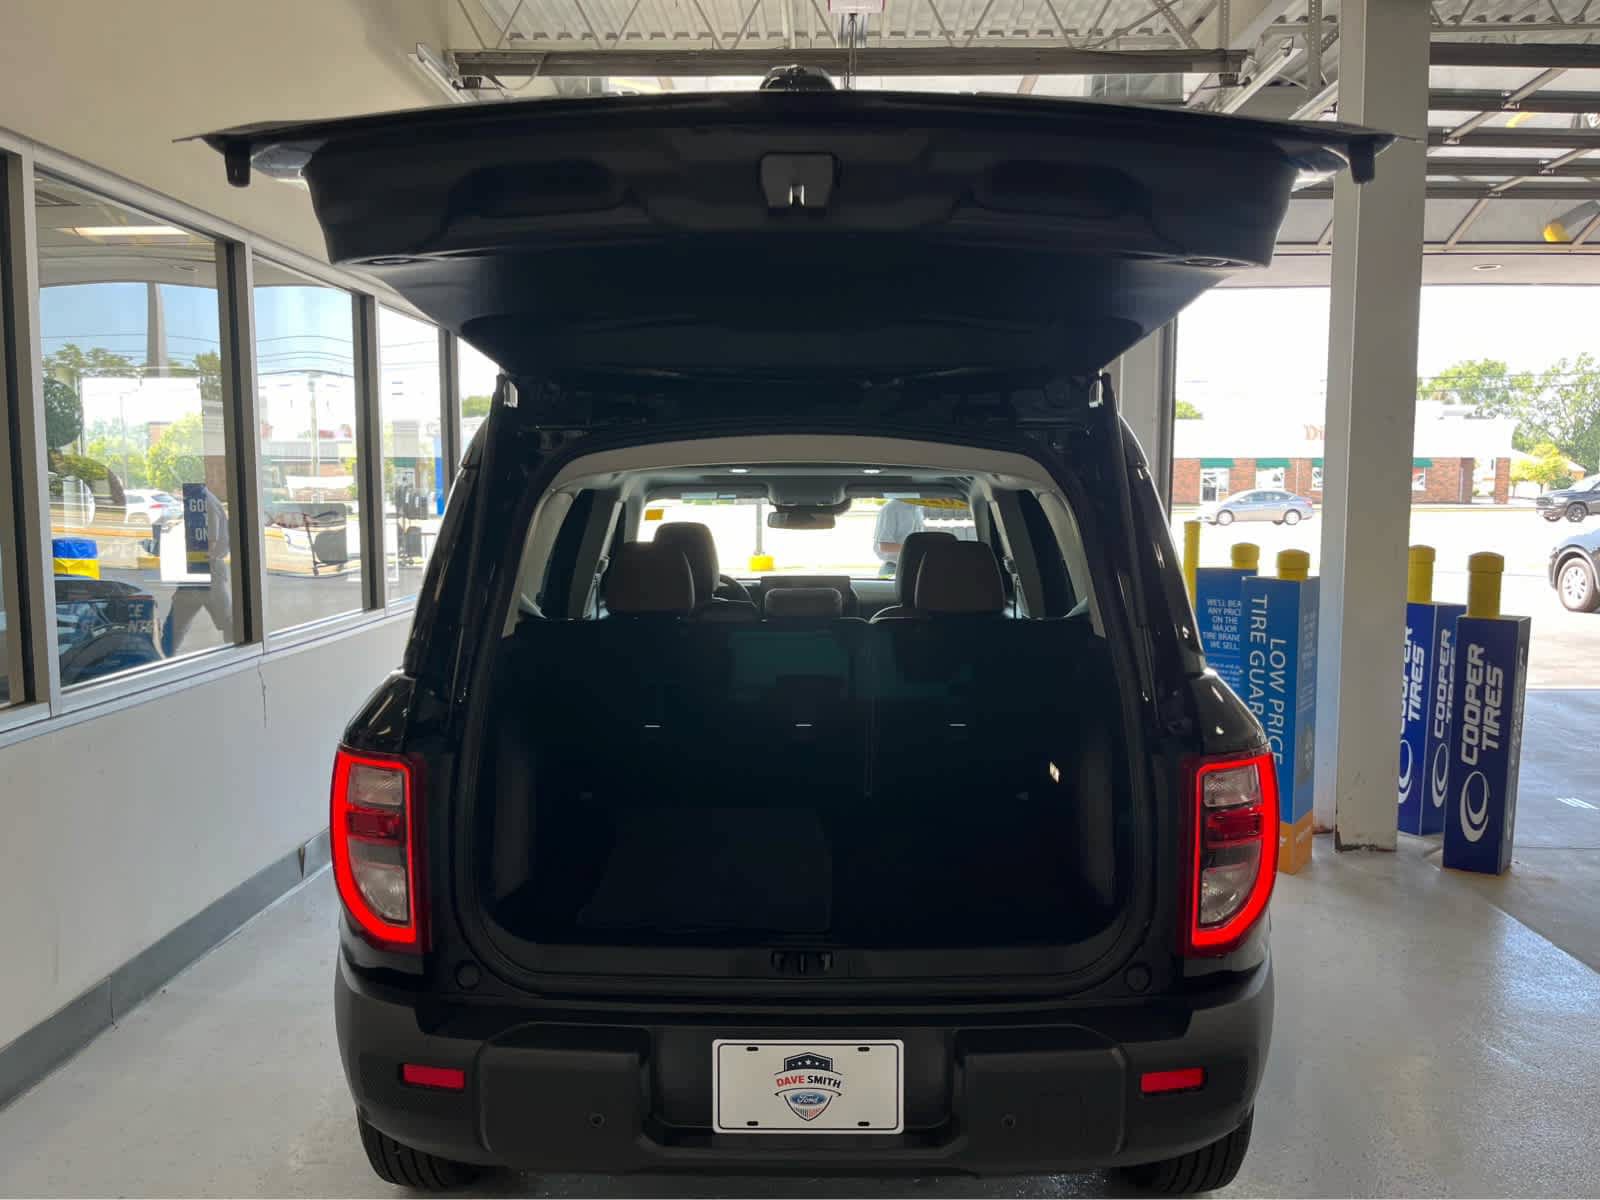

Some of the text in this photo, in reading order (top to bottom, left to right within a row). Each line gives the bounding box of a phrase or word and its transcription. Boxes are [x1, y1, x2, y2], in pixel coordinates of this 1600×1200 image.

[1208, 607, 1241, 616] ANY PRIC
[1212, 616, 1238, 624] ON THE
[1212, 624, 1238, 633] MAJOR
[1202, 632, 1217, 640] TIRE
[1210, 641, 1221, 649] WE
[1248, 594, 1268, 718] TIRE GUAR
[1268, 638, 1287, 693] LOW
[1407, 643, 1425, 722] TIRES
[1434, 628, 1452, 739] COOPER
[1461, 643, 1485, 766] COOPER
[1482, 664, 1503, 751] TIRES
[776, 1075, 842, 1089] DAVE SMITH
